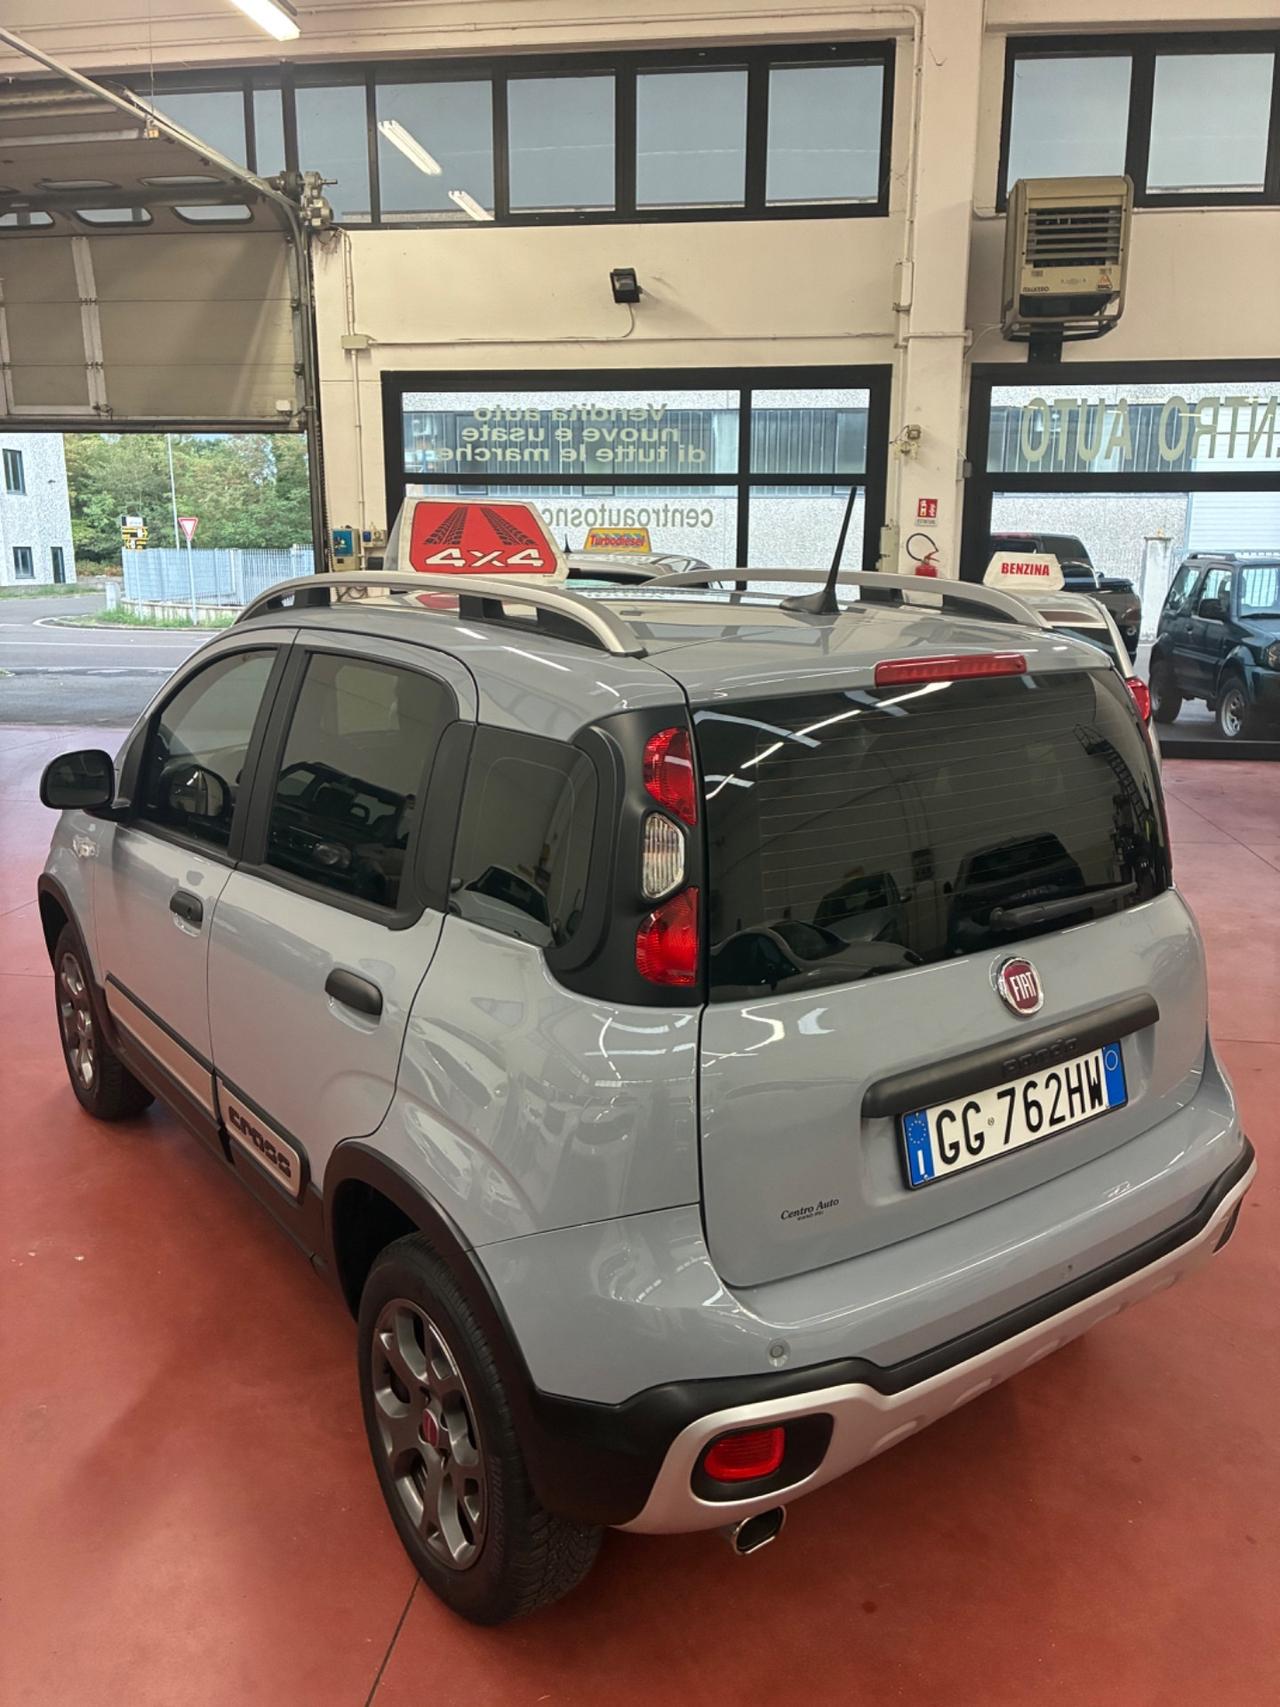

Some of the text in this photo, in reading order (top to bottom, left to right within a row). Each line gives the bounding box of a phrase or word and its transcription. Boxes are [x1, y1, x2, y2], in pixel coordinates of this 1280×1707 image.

[1001, 562, 1050, 577] BENZINA
[1009, 971, 1037, 1003] FIAT
[935, 1100, 986, 1166] GG
[996, 1055, 1105, 1145] 762HW
[780, 1206, 815, 1221] Centro
[816, 1198, 840, 1211] Auto
